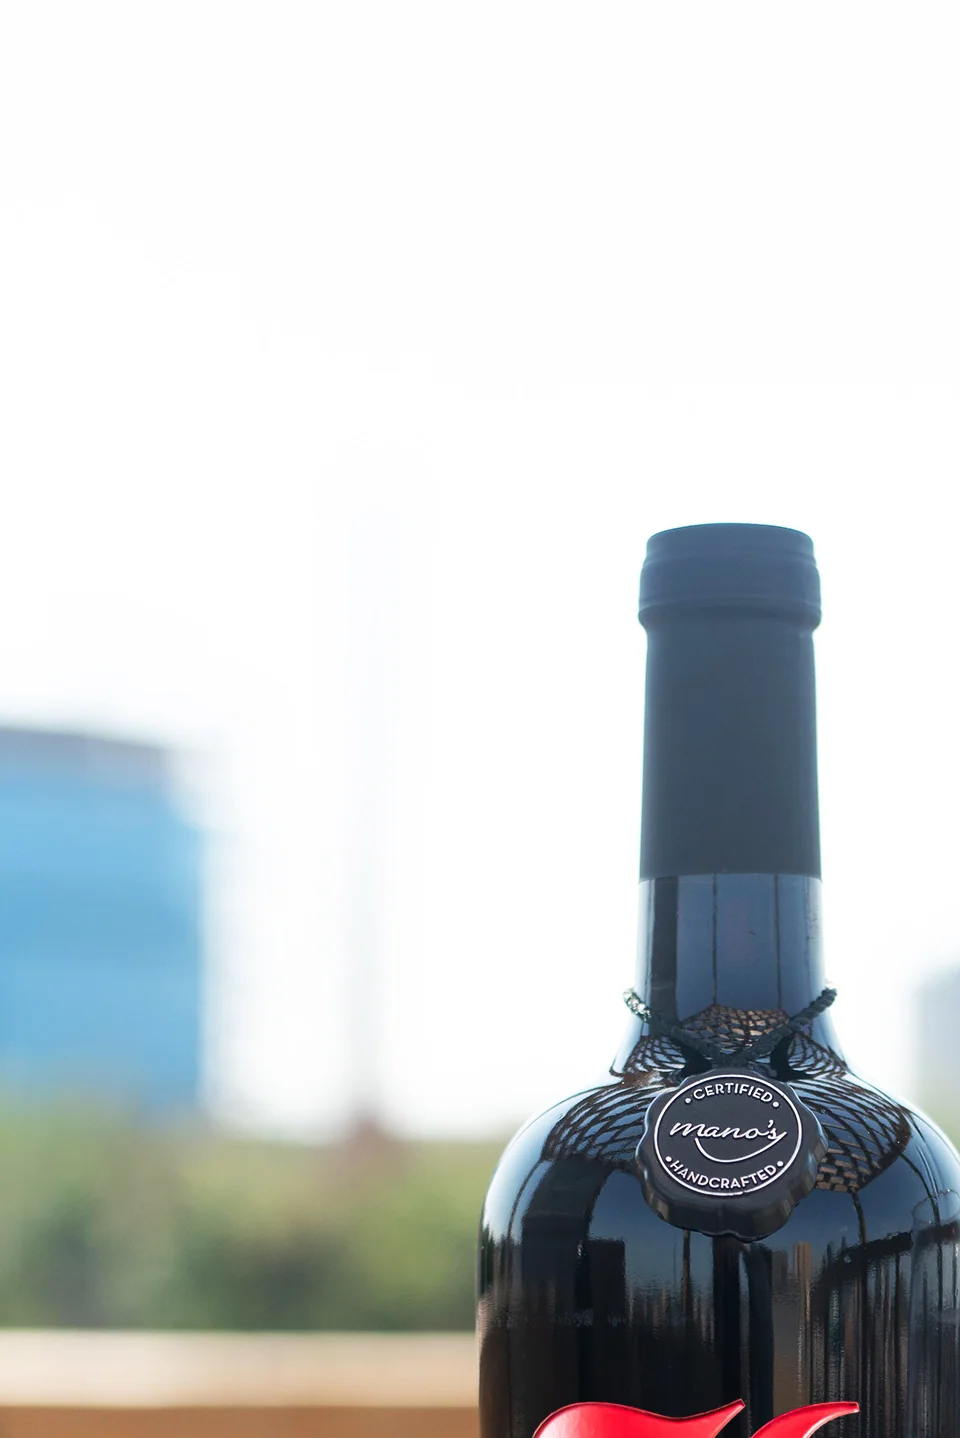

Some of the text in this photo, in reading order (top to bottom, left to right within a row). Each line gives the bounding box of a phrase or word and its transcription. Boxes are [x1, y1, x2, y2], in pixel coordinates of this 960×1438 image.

[693, 1082, 774, 1103] CERTIFIED
[669, 1119, 788, 1143] mano's
[669, 1160, 777, 1189] HANDCRAFTED
